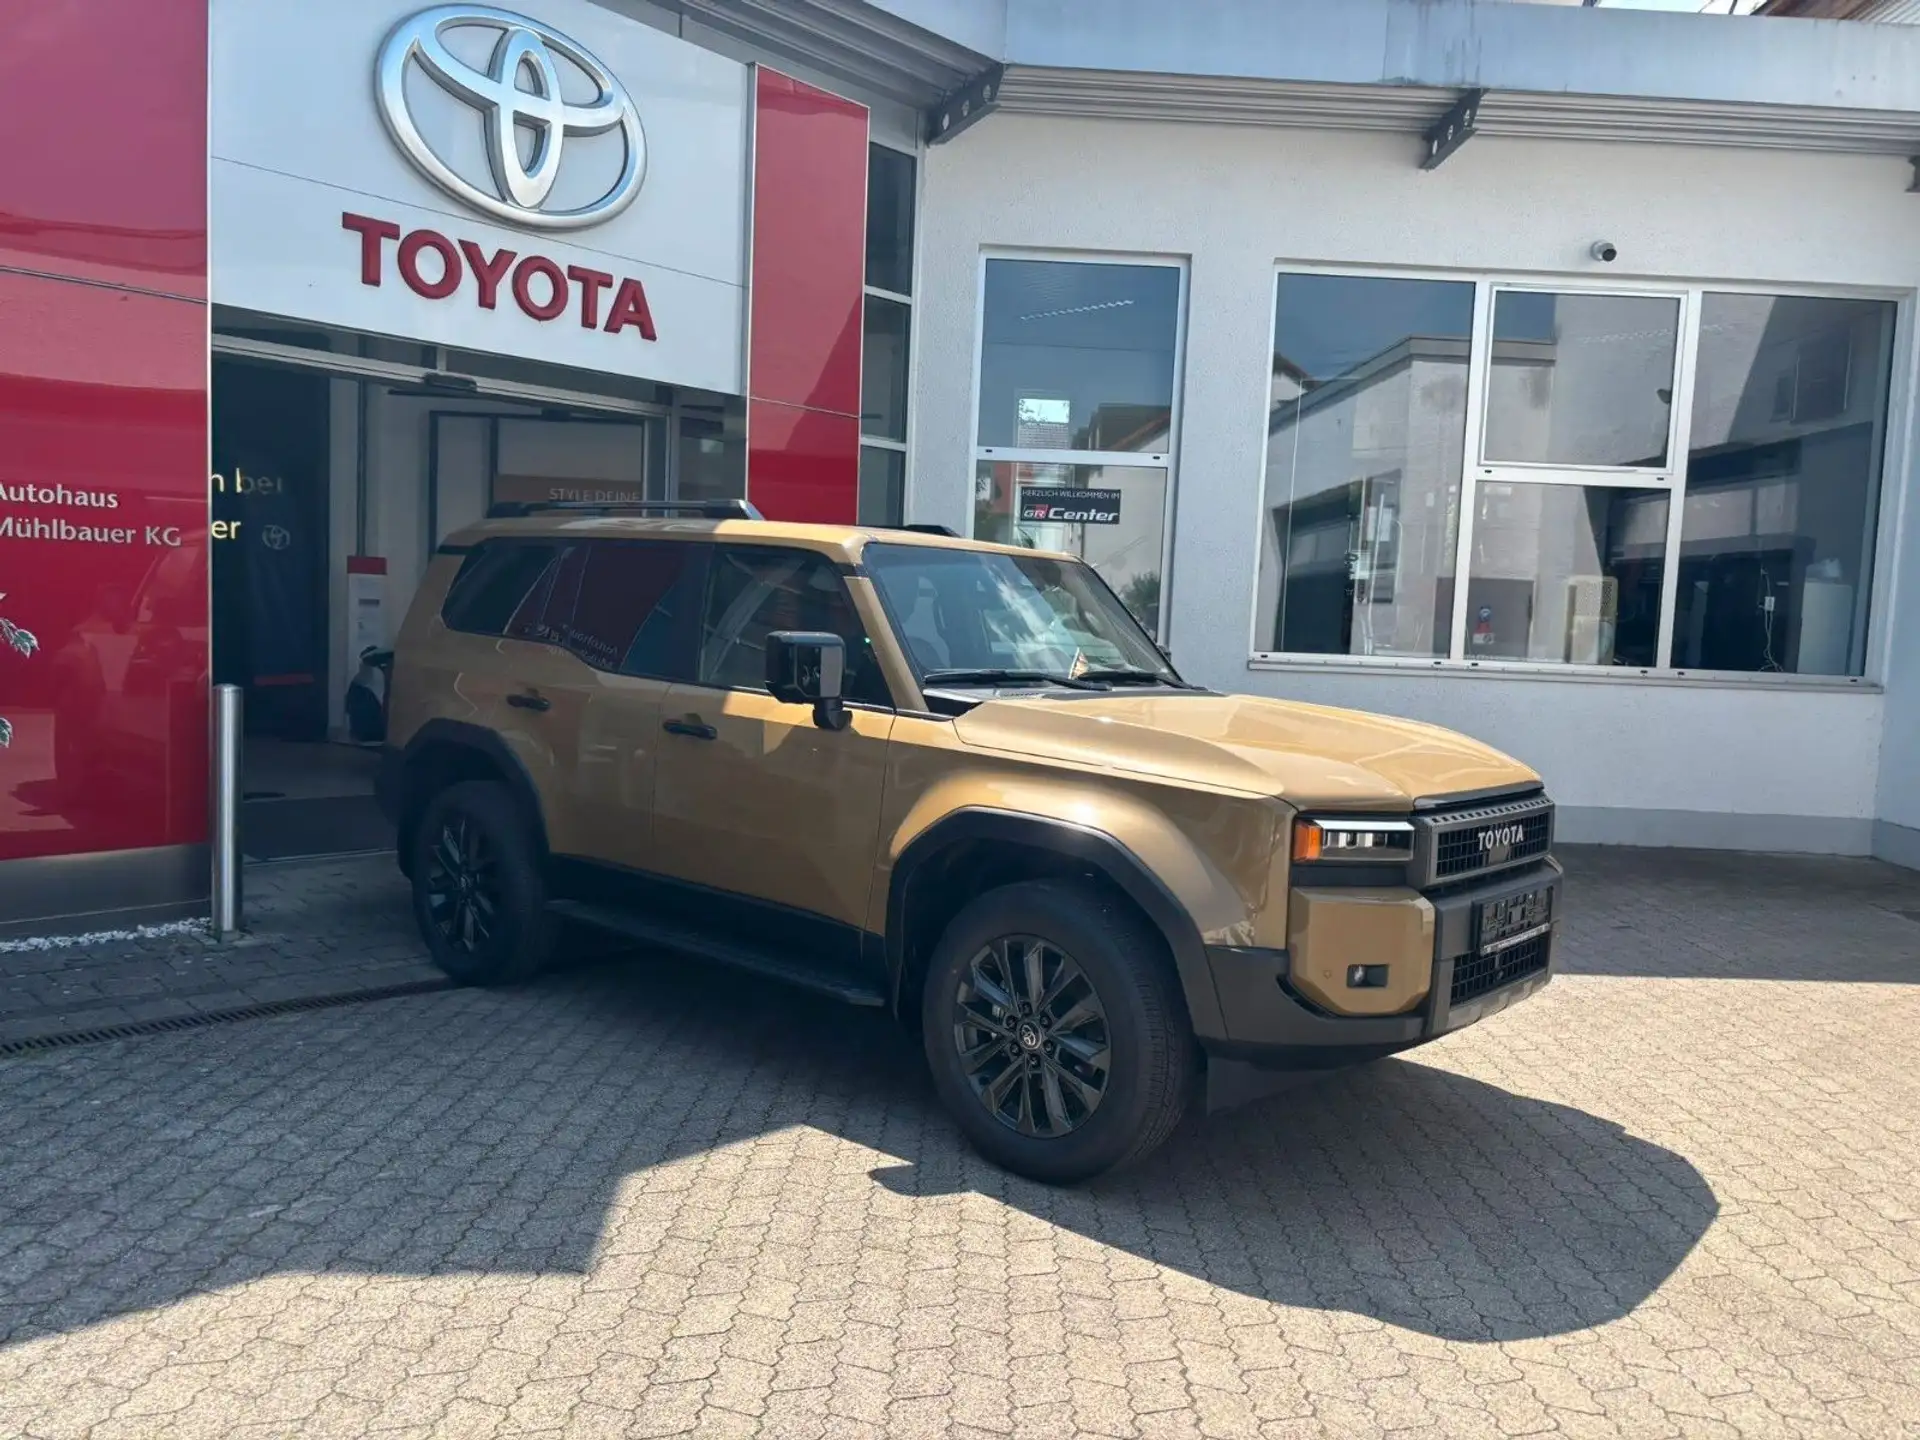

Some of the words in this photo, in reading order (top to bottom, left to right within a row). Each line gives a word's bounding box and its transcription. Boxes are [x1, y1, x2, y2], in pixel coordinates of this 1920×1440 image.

[342, 211, 657, 341] TOYOTA
[0, 482, 119, 508] Autohaus
[549, 488, 591, 502] STYLE
[1022, 489, 1059, 497] HERZLICH
[1060, 489, 1109, 499] WILLKOMMEN
[1024, 507, 1048, 519] GR
[1048, 507, 1119, 522] Center
[0, 516, 136, 544] Mühlbauer
[145, 525, 182, 546] KG
[1478, 824, 1524, 851] TOYOTA
